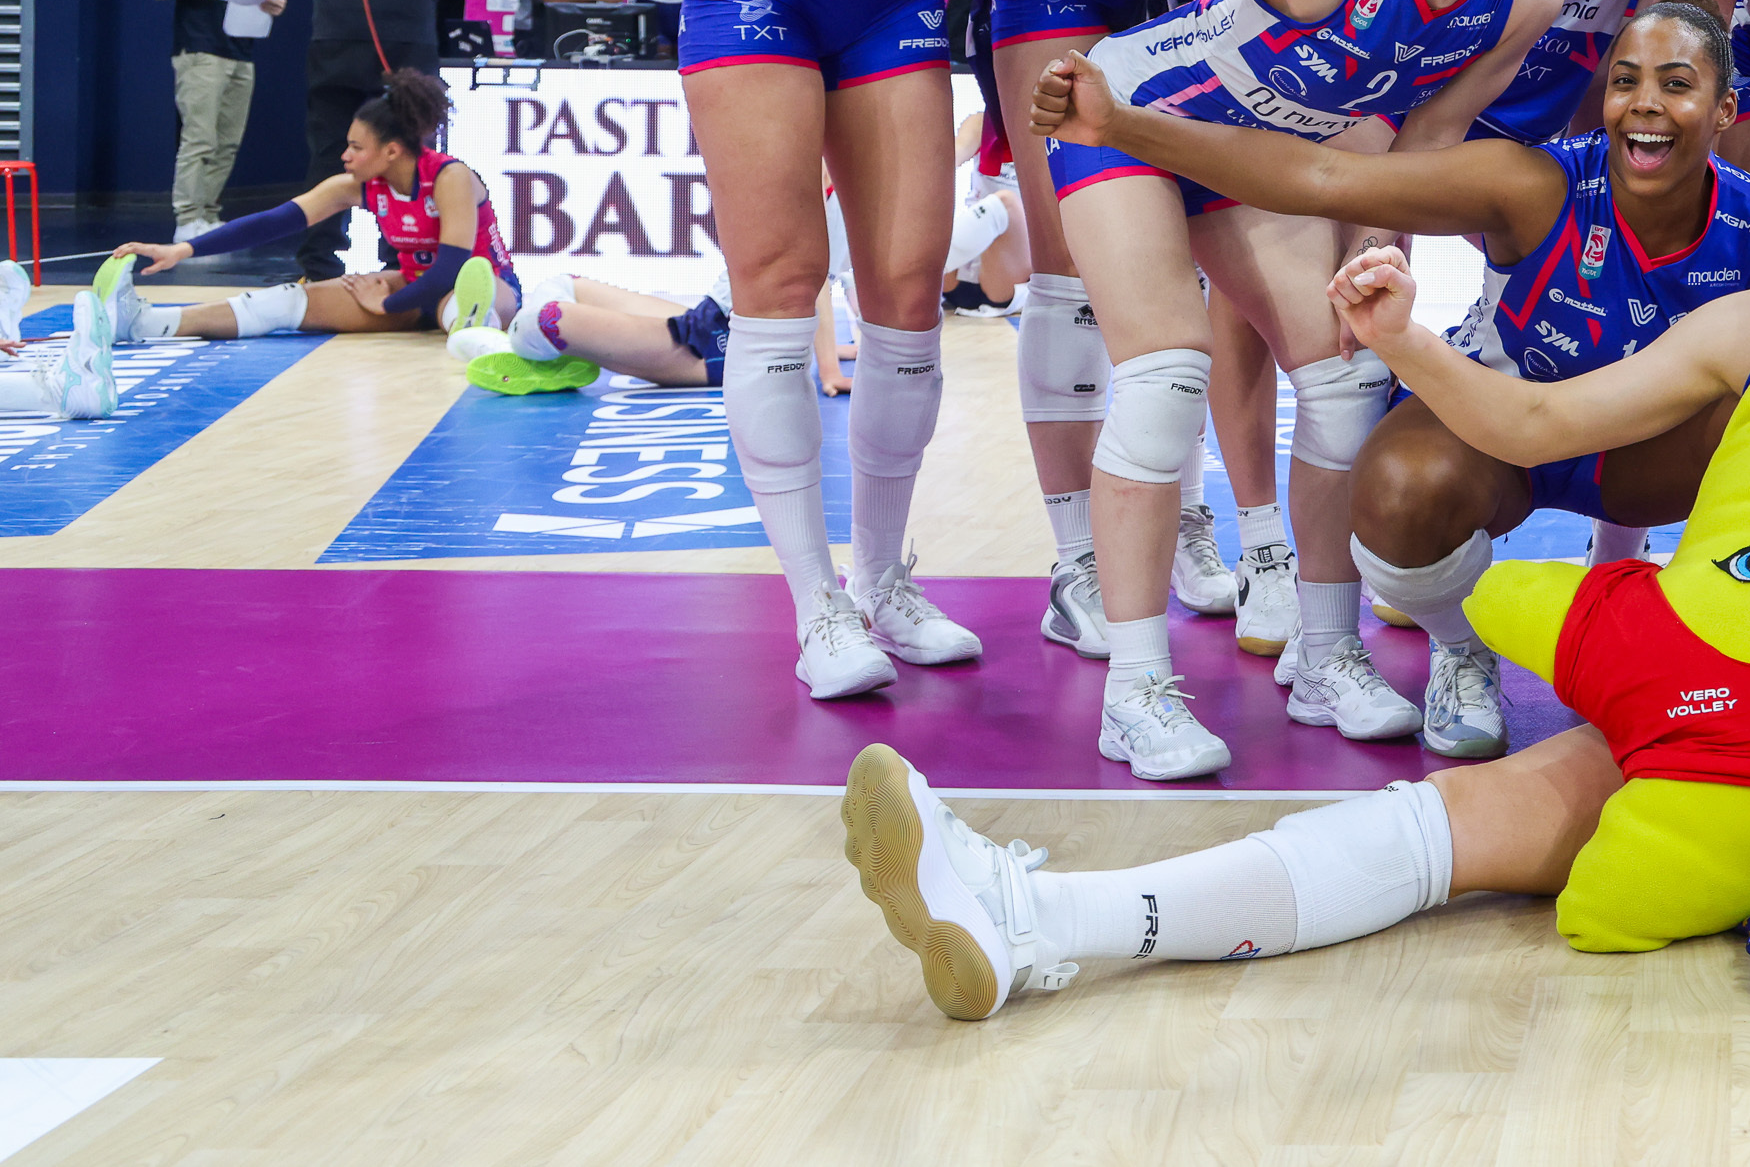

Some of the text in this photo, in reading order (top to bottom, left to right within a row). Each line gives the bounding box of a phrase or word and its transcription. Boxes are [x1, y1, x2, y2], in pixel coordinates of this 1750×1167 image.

[733, 24, 788, 41] TXT
[1293, 43, 1339, 84] SYM
[1338, 69, 1399, 112] 2
[1687, 267, 1741, 285] mauden
[1533, 319, 1580, 358] SYM
[767, 363, 806, 374] FREDDY
[1170, 382, 1204, 396] FREDDY
[1679, 685, 1731, 702] VERO
[1665, 696, 1739, 720] VOLLEY
